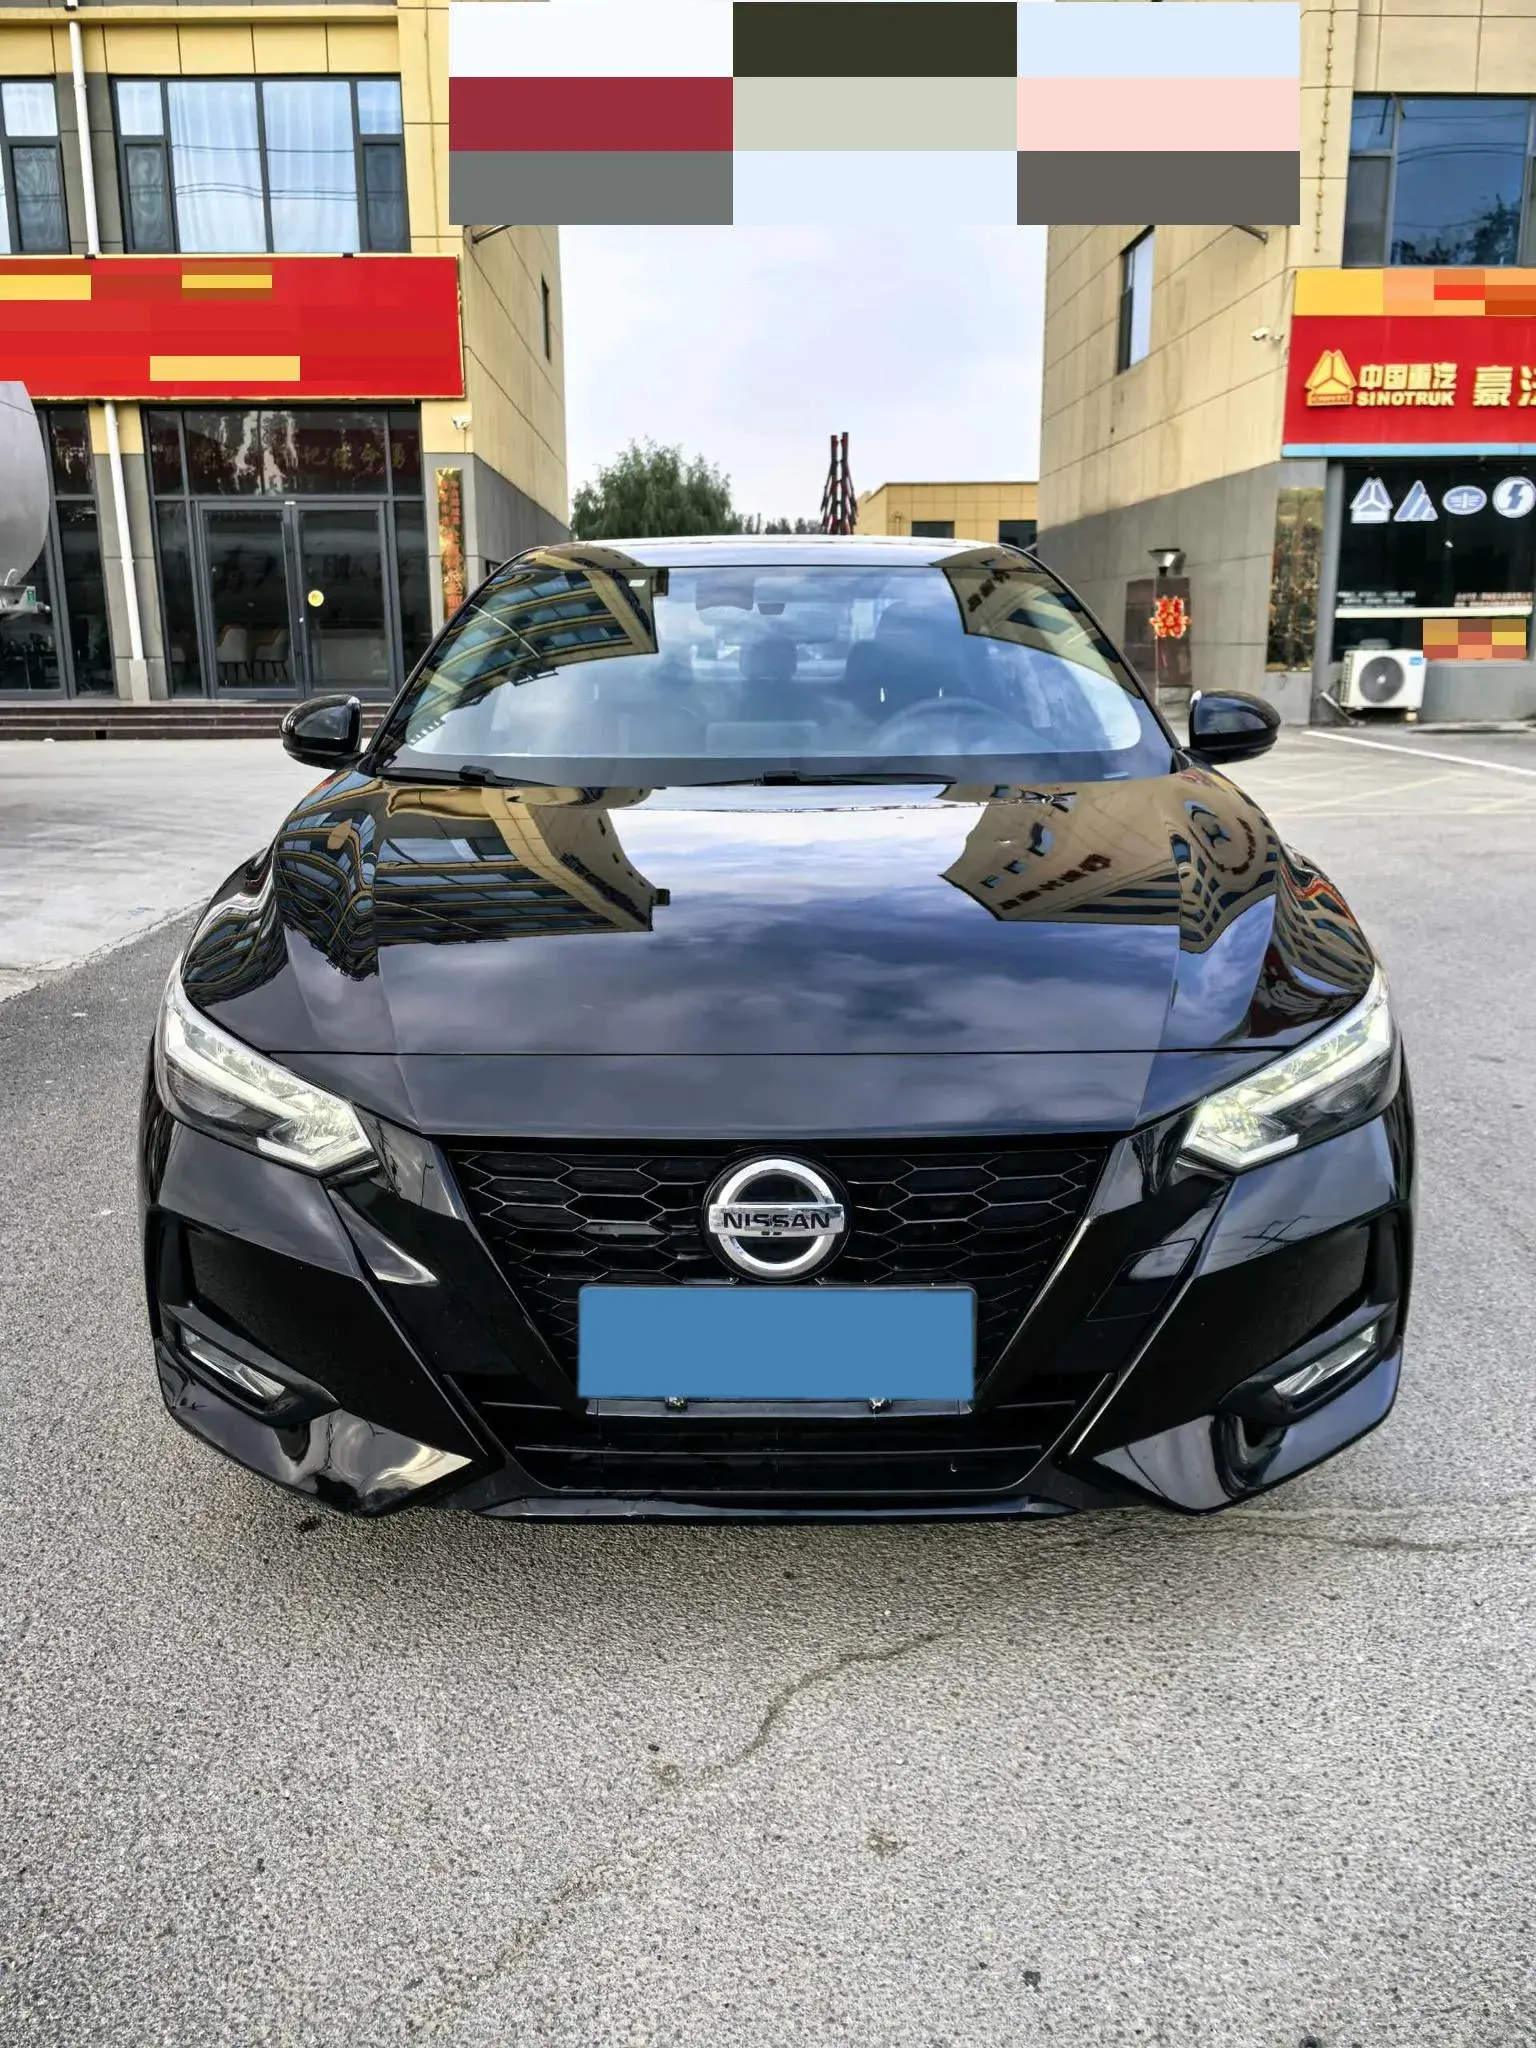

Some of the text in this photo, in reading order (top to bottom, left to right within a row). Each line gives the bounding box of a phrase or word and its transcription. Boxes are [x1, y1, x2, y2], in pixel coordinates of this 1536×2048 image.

[1359, 362, 1457, 390] 中国重汽
[1356, 391, 1455, 406] SINOTRUK
[723, 1212, 830, 1229] NISSAN
